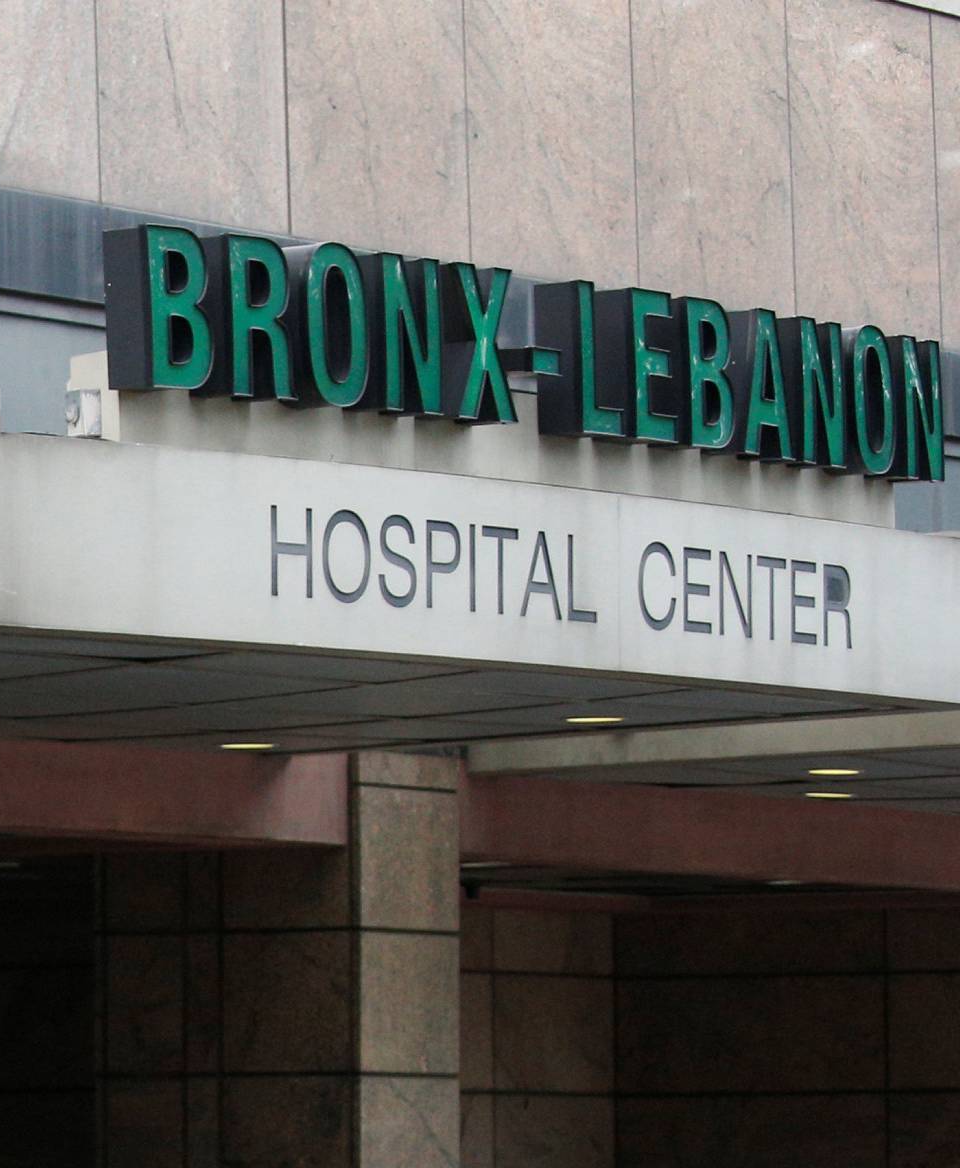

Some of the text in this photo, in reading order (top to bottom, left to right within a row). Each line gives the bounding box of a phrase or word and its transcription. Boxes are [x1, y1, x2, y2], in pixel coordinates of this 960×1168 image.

[140, 223, 945, 482] BRONX-LEBANON
[270, 504, 853, 649] HOSPITAL CENTER
